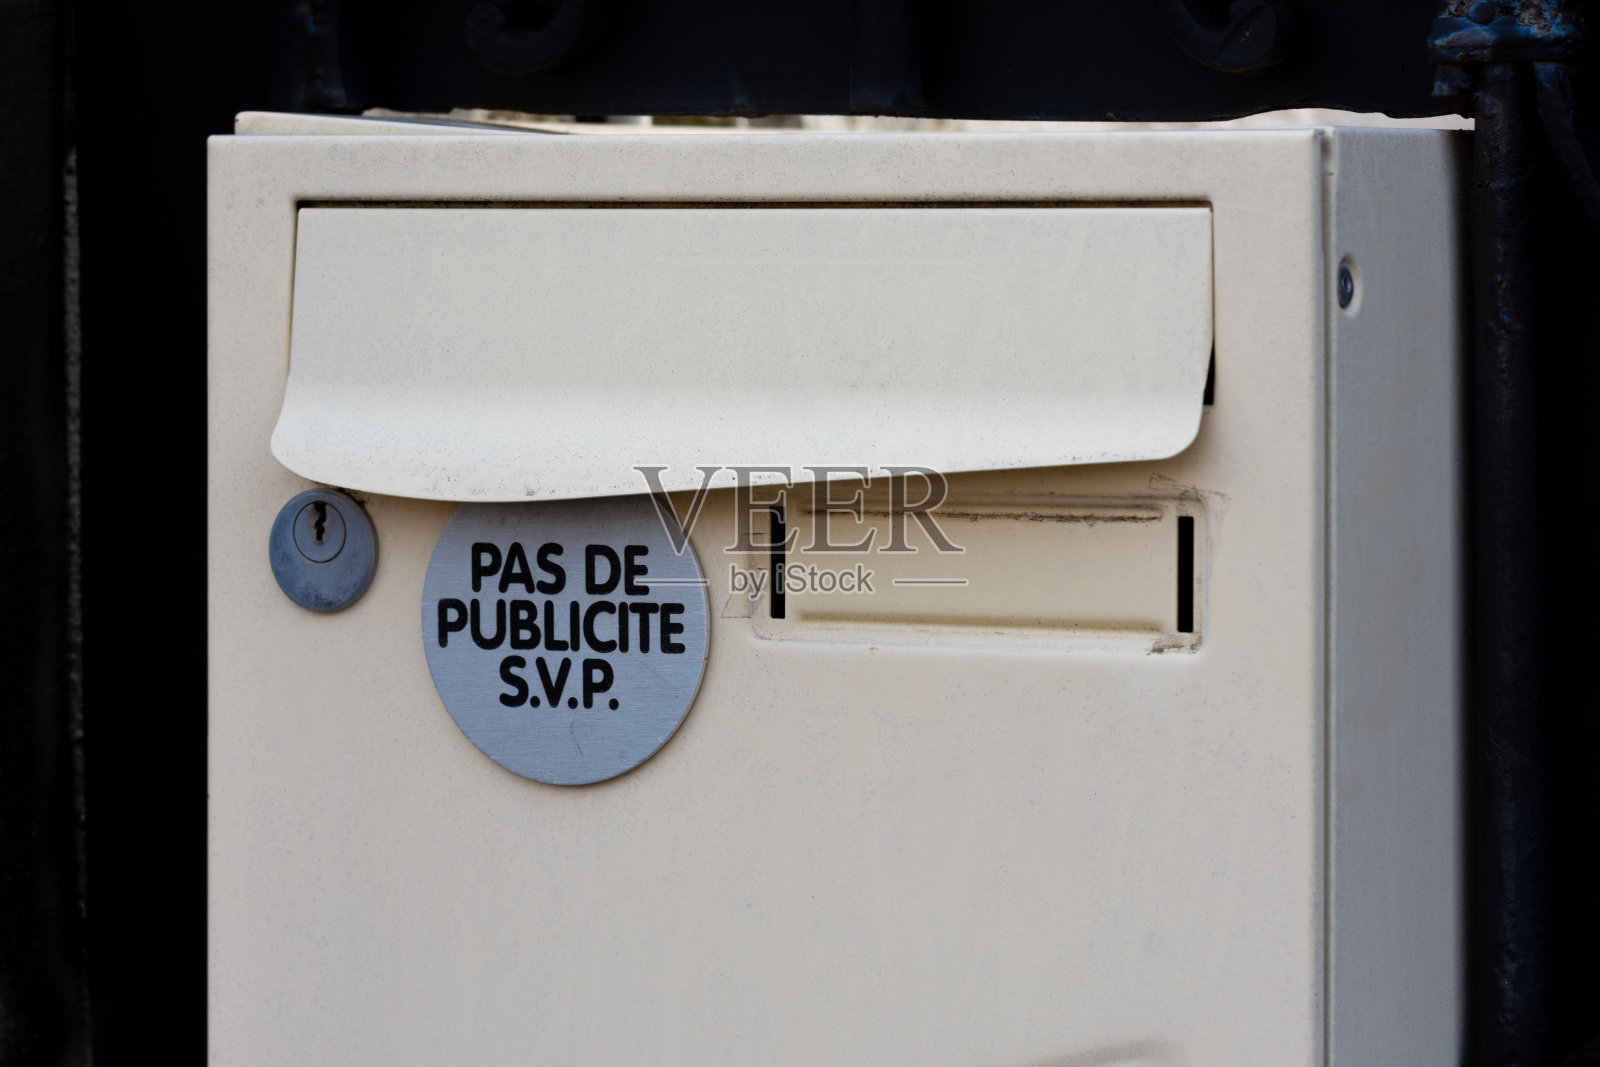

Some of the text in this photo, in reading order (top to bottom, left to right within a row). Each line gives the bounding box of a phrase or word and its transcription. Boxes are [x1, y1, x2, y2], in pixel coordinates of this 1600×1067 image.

[470, 542, 650, 596] PAS DE
[437, 598, 686, 654] PUBLICITE
[499, 655, 620, 711] S.V.P.
